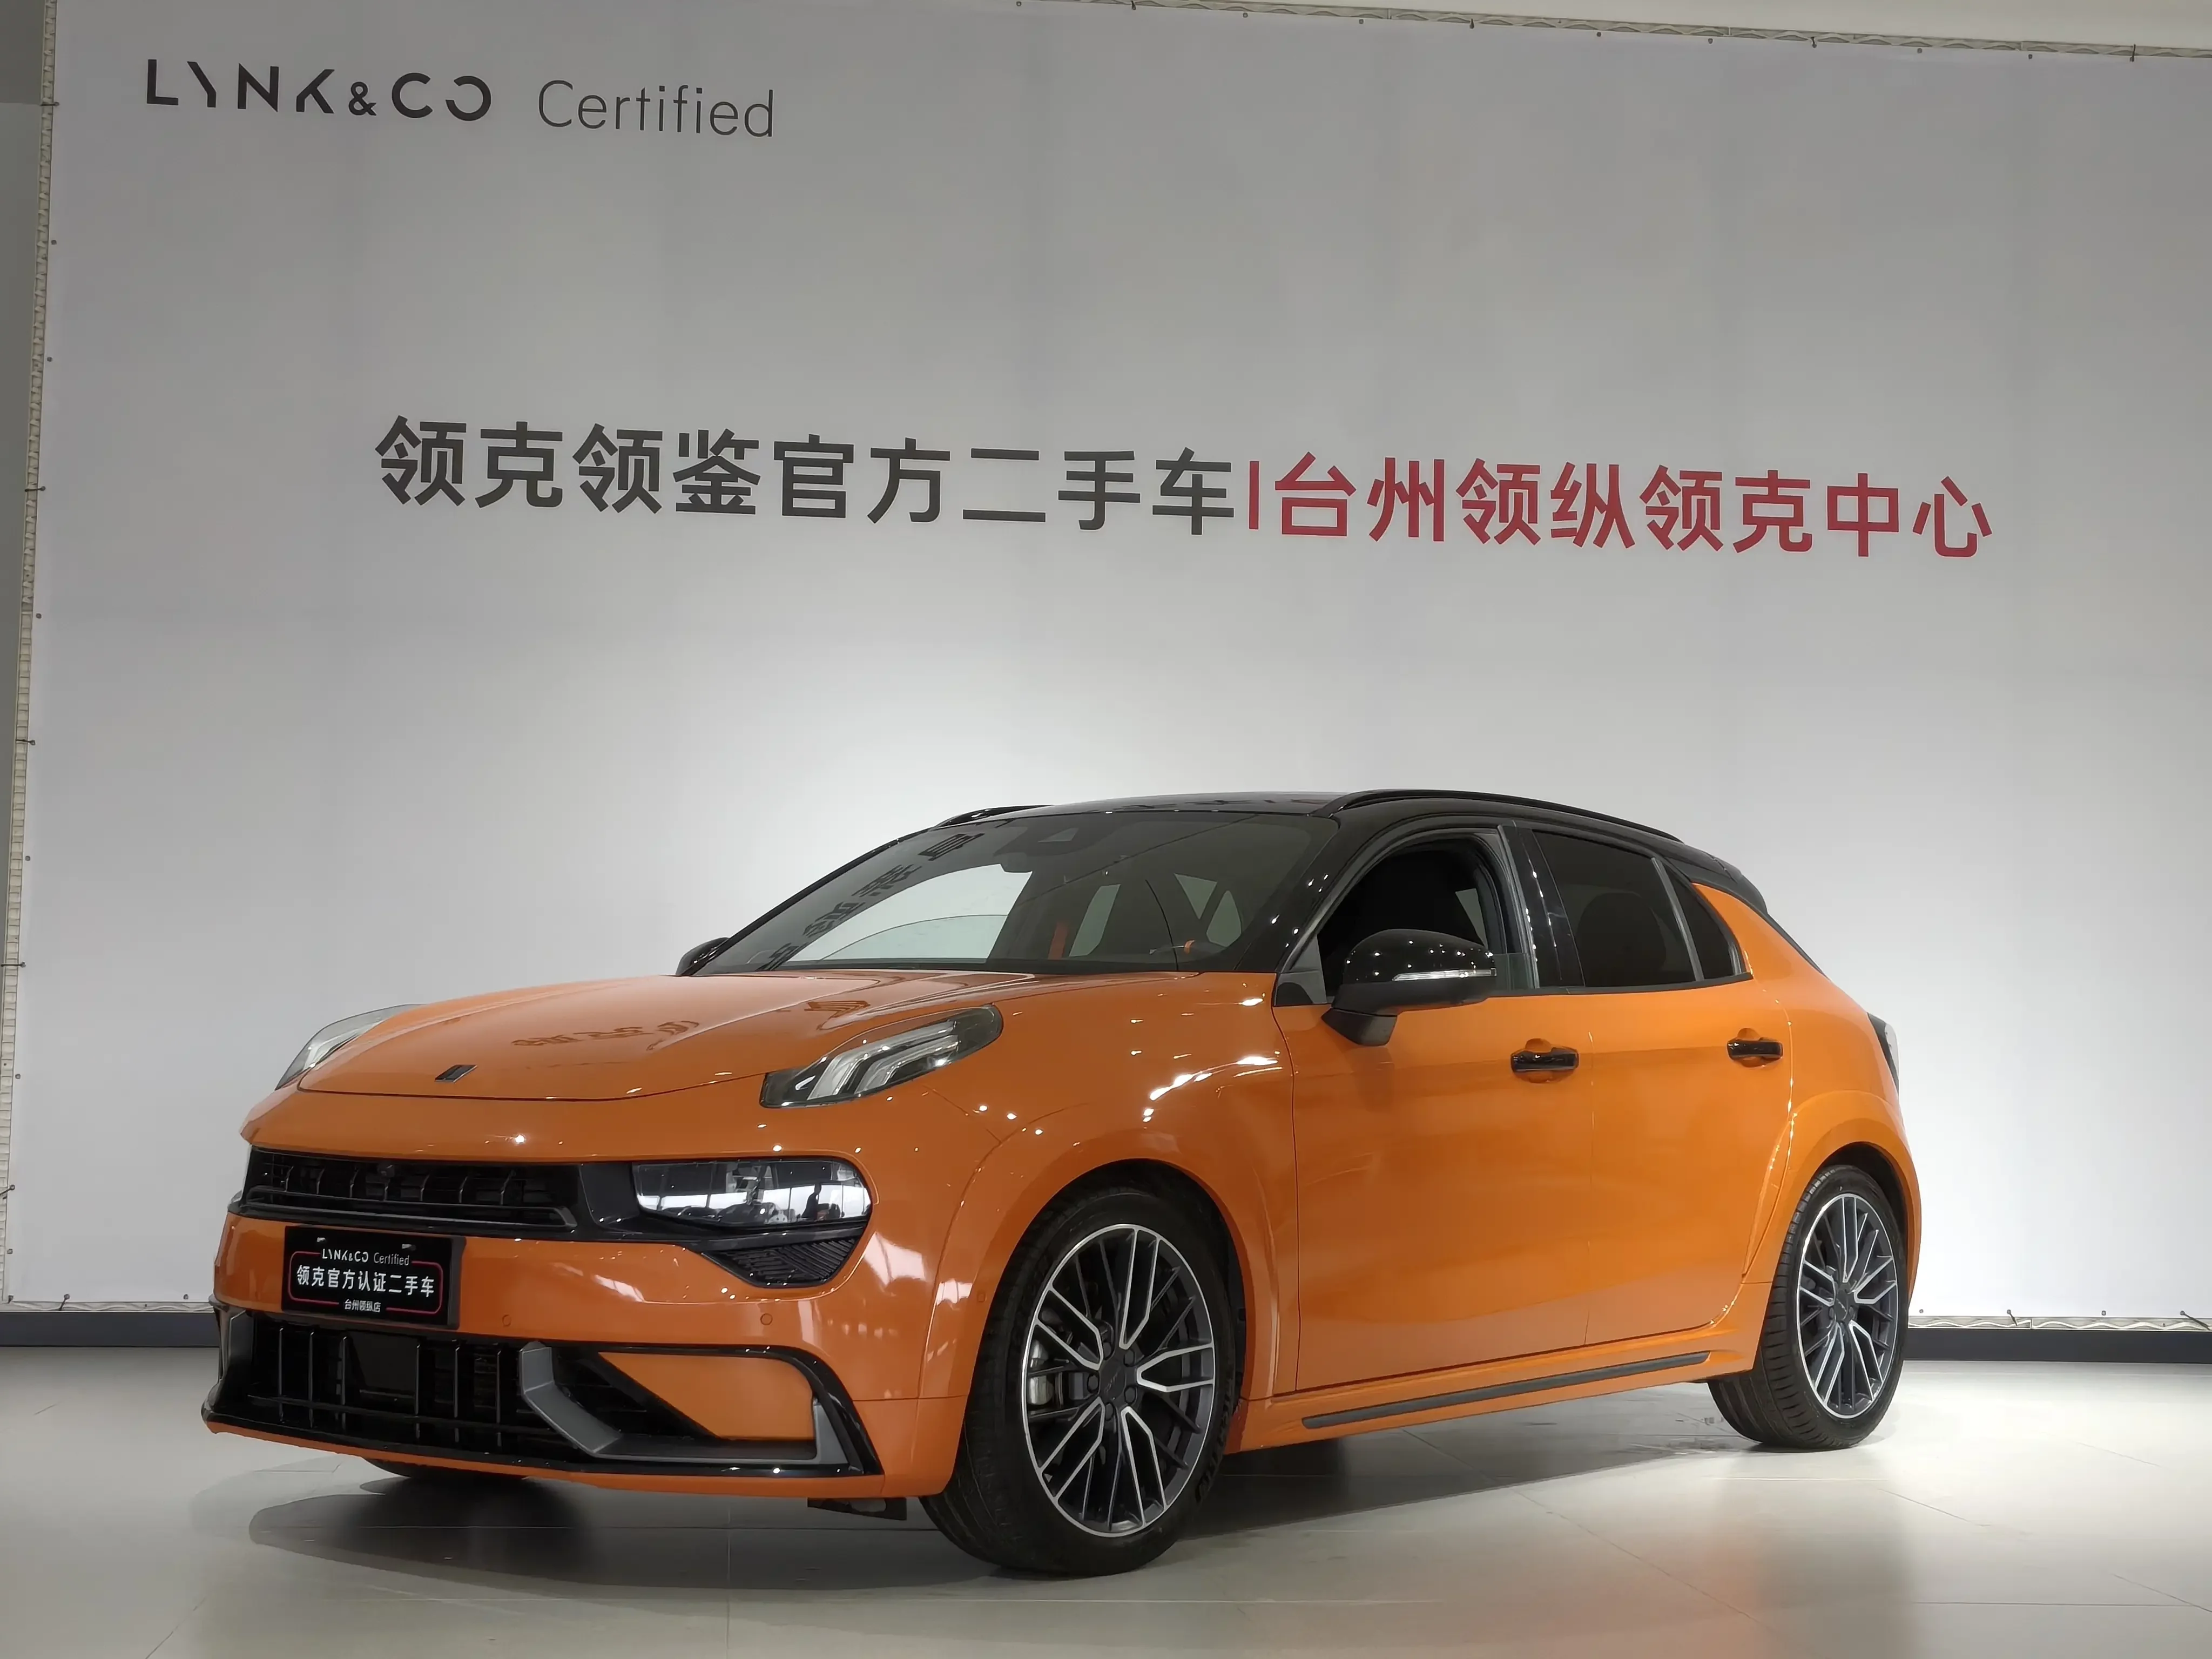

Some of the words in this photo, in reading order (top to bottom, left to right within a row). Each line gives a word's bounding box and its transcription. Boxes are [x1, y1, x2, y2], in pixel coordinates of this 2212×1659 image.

[538, 80, 774, 137] Certified
[374, 1252, 410, 1266] Certified
[296, 1264, 435, 1298] 领克官方认证二手车
